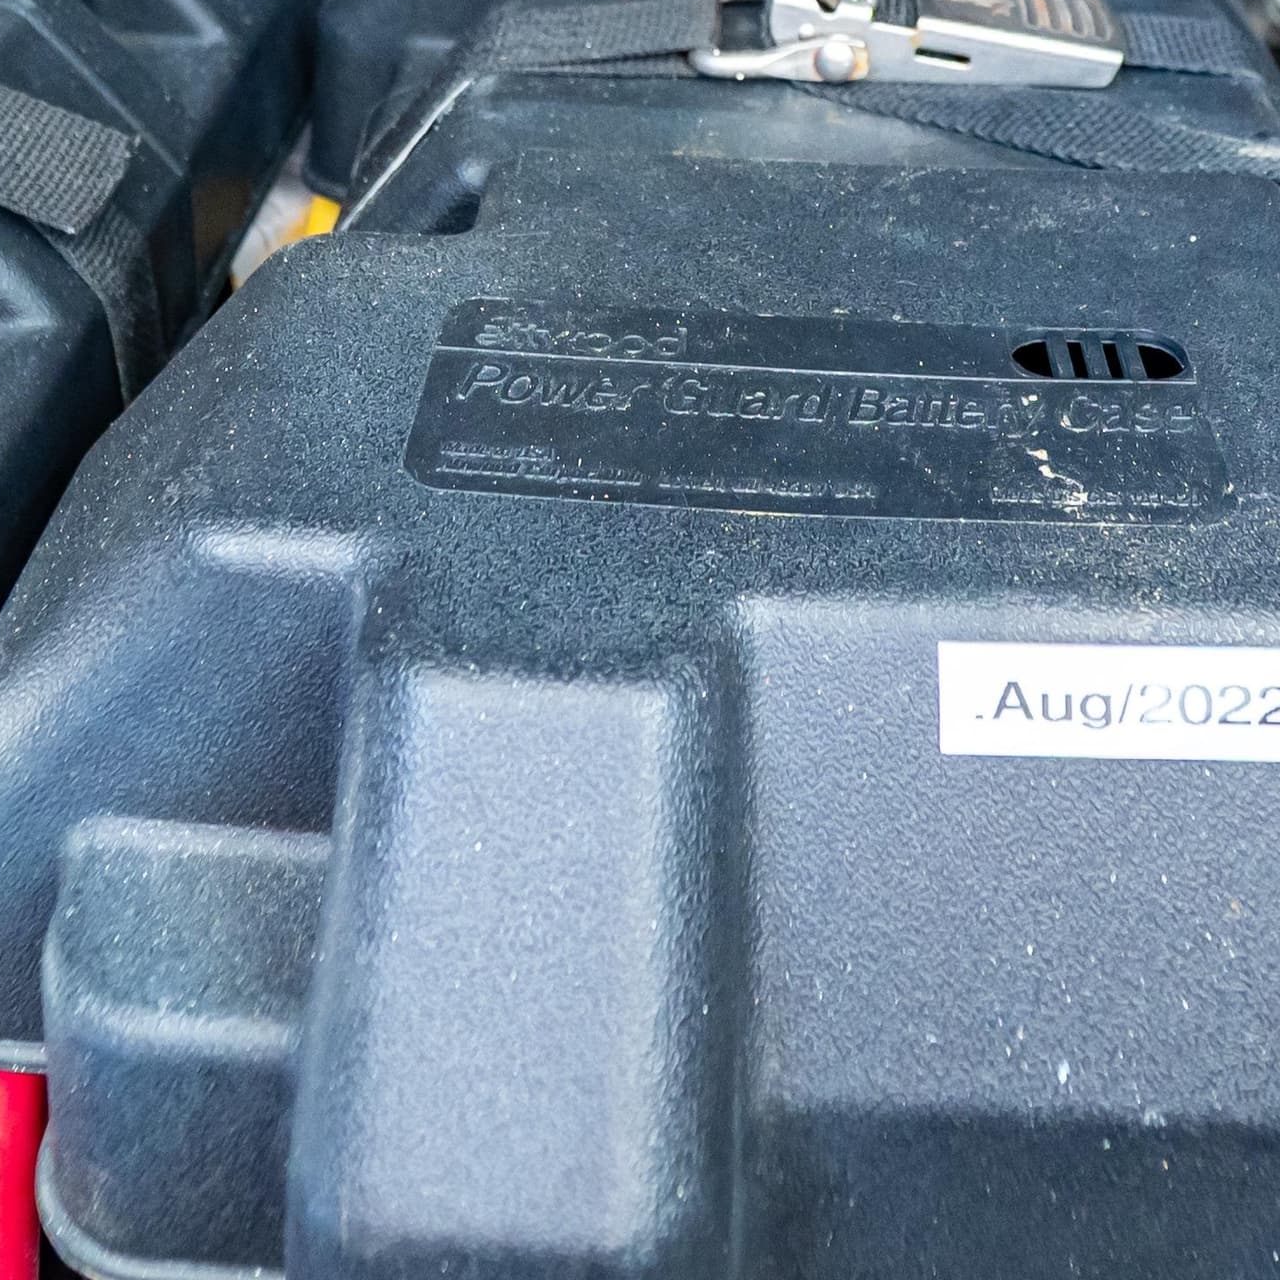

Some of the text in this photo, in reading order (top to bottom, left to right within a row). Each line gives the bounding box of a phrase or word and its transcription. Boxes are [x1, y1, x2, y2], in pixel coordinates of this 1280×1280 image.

[454, 361, 1197, 438] Power Guard Battery Case
